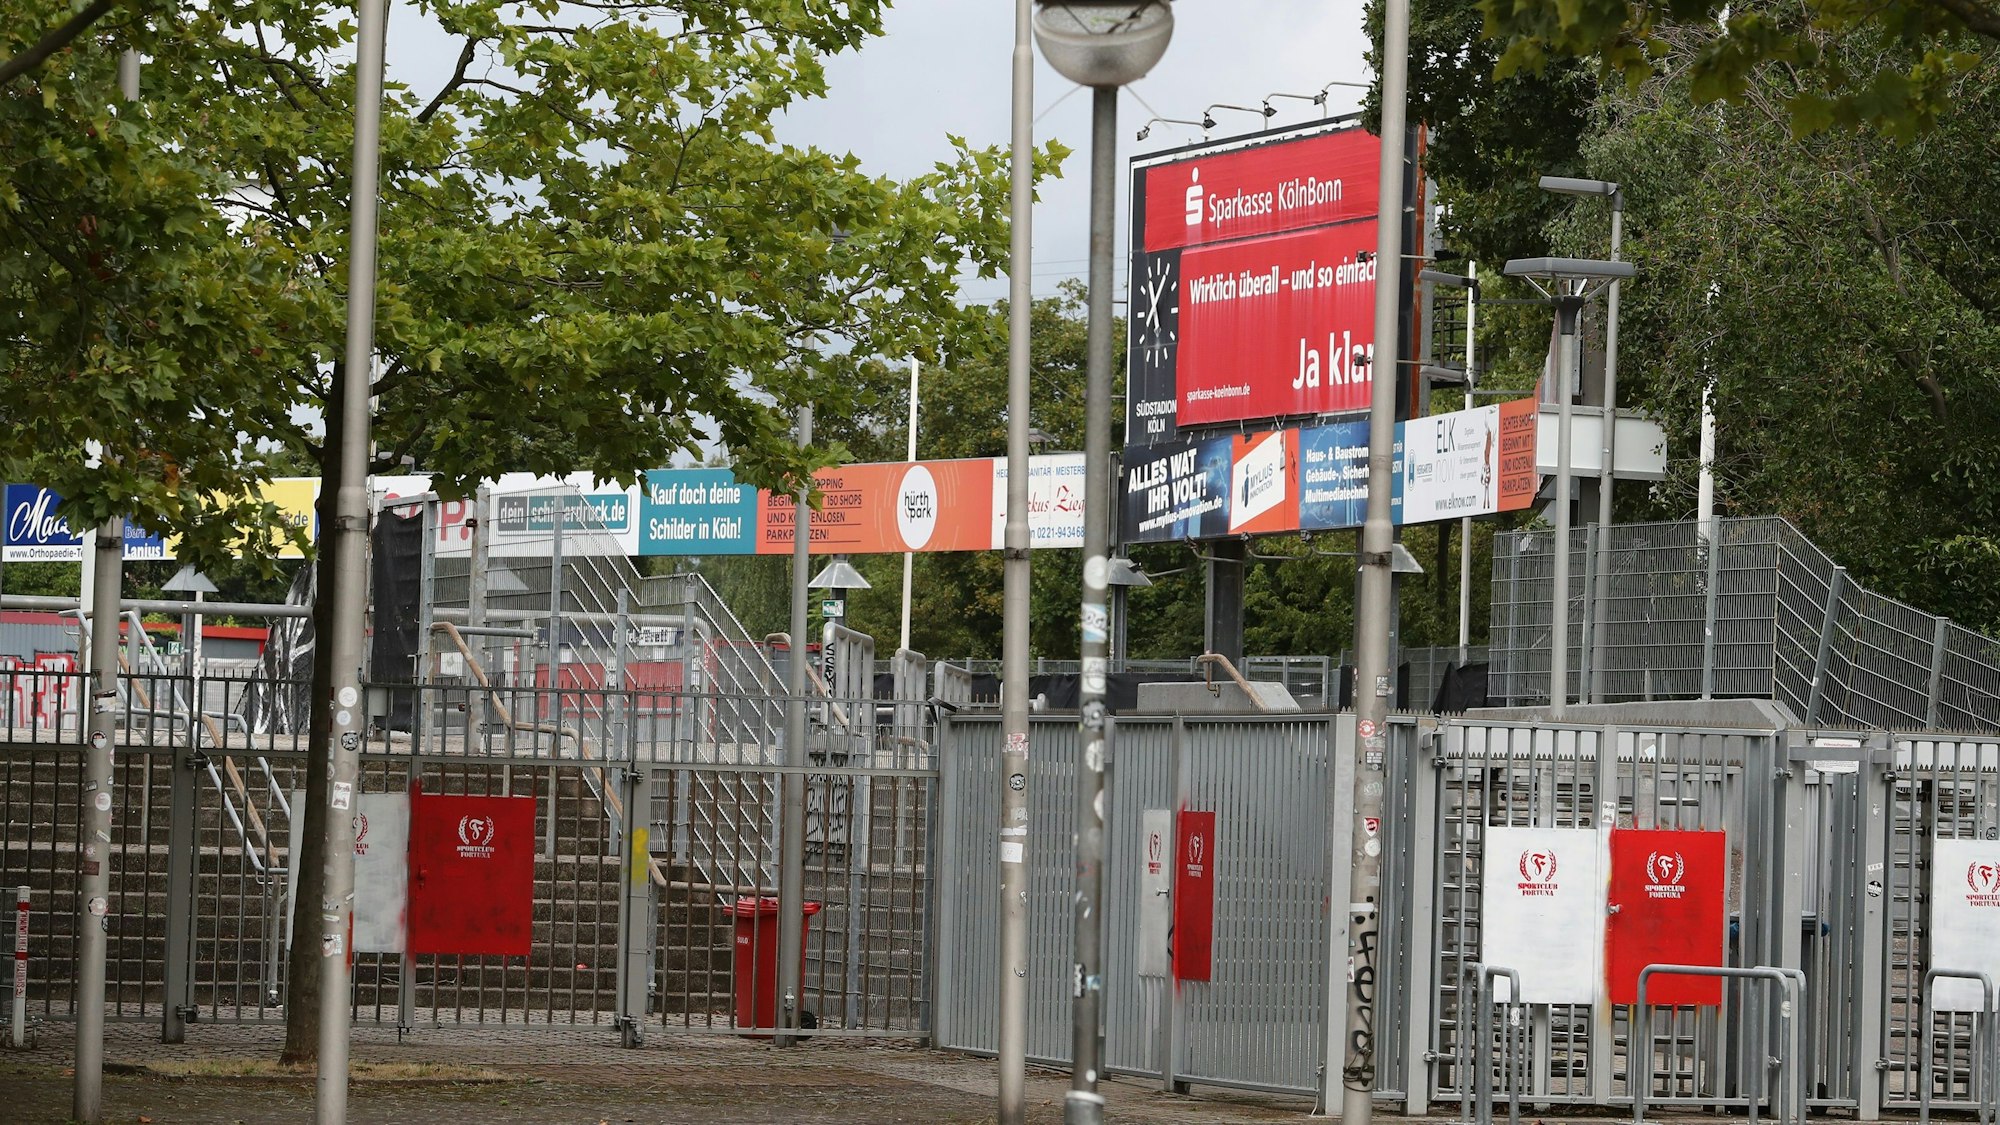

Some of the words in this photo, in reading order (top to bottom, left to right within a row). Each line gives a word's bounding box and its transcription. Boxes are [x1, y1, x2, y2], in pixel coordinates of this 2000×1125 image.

[1208, 188, 1272, 227] Sparkasse
[1278, 177, 1342, 211] KölnBonn
[1189, 273, 1236, 304] Wirklich
[1239, 265, 1279, 298] überall
[1291, 260, 1314, 291] und
[1317, 266, 1332, 288] so
[1292, 338, 1320, 390] Ja
[1186, 384, 1250, 403] sparkasse-koelnbonn.de
[1136, 399, 1177, 417] SÜDSTADION
[1147, 416, 1165, 433] KÖLN
[1437, 417, 1456, 454] ELK
[1306, 448, 1327, 463] Haus-
[1328, 446, 1333, 461] &
[1335, 445, 1369, 461] Baustrom
[1028, 465, 1052, 477] ANITÄR
[1128, 457, 1168, 493] ALLES
[1170, 448, 1197, 479] WAT
[1250, 463, 1273, 488] MYLIUS
[650, 483, 677, 505] Kauf
[679, 483, 707, 505] doch
[708, 483, 741, 504] deine
[827, 495, 839, 506] 150
[840, 494, 862, 505] SHOPS
[904, 491, 929, 509] hürth
[1148, 485, 1169, 513] IHR
[1172, 471, 1207, 505] VOLT!
[1305, 485, 1369, 503] Multimediatechnik
[500, 502, 524, 524] dein
[530, 499, 625, 523] schierdruck.de
[767, 512, 786, 523] UND
[908, 505, 932, 522] park
[1138, 494, 1223, 532] www.mylius-innovation.de
[649, 518, 697, 541] Schilder
[699, 518, 710, 540] in
[712, 517, 741, 540] Köln!
[766, 528, 830, 541] PARKPZEN!
[124, 542, 161, 557] Lanius
[1518, 882, 1558, 890] SPORTCLUB
